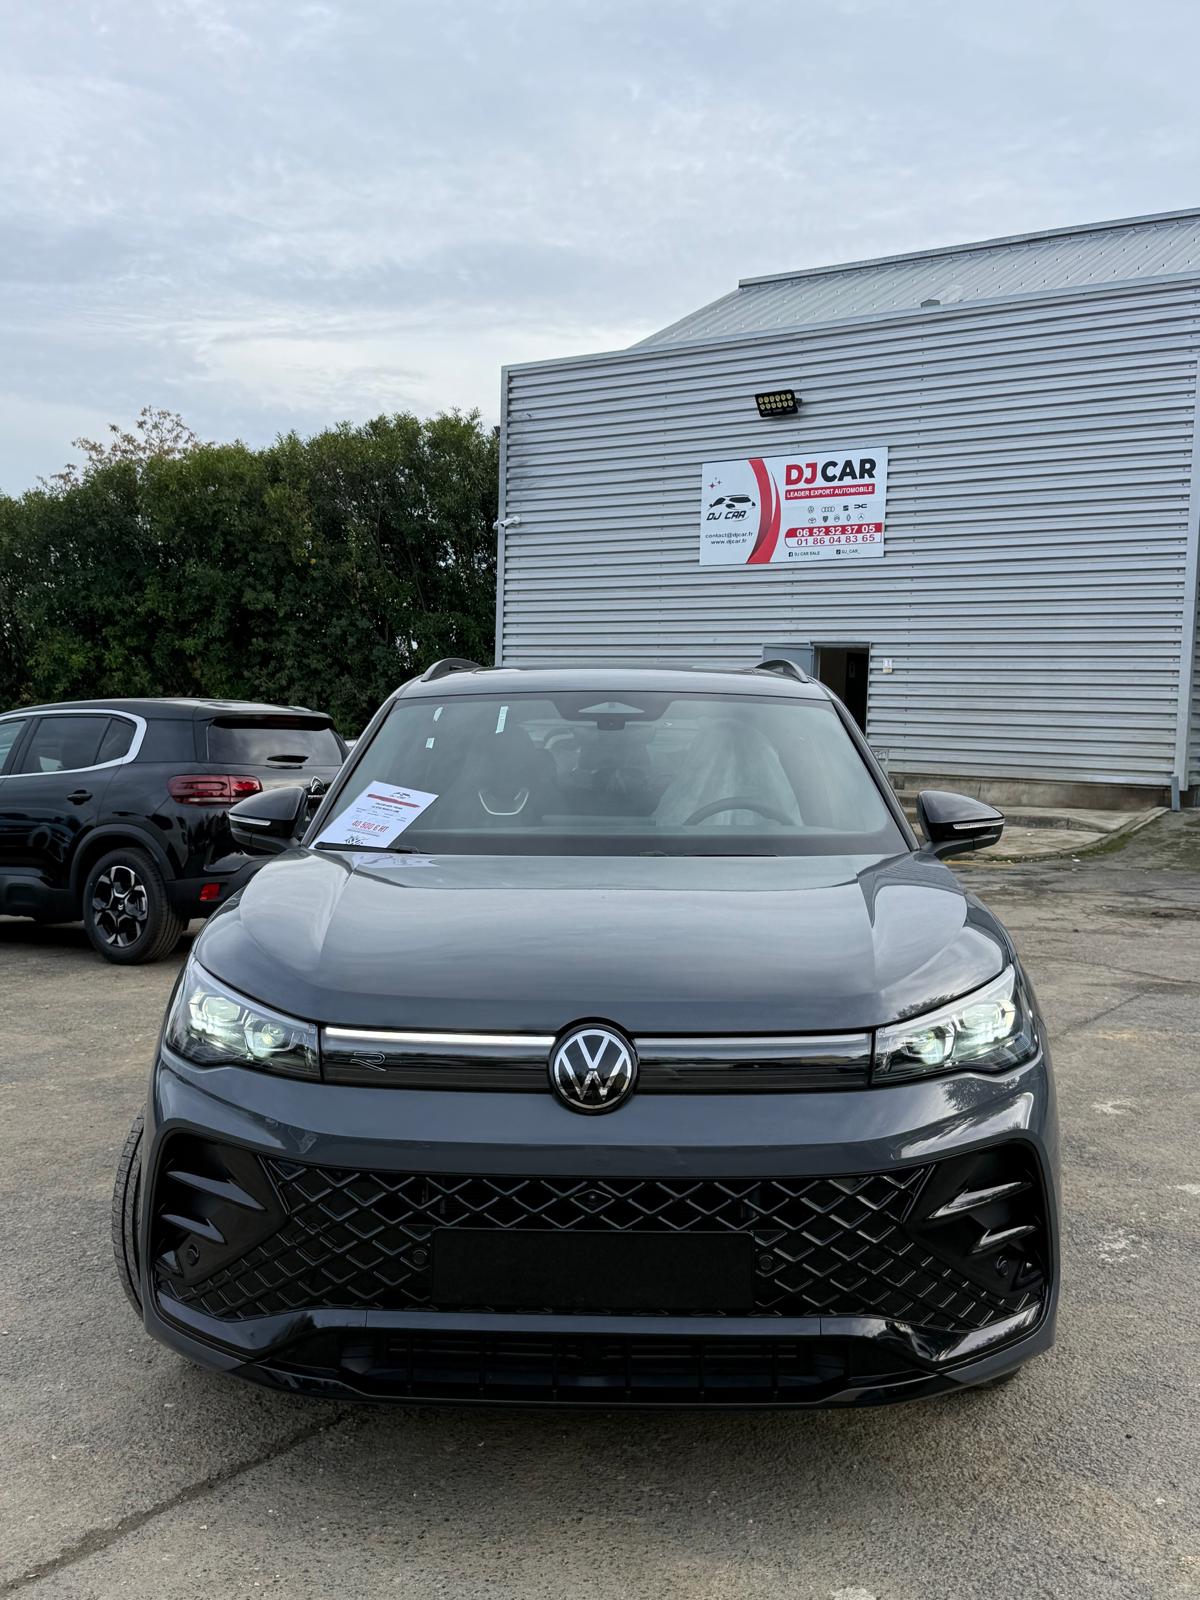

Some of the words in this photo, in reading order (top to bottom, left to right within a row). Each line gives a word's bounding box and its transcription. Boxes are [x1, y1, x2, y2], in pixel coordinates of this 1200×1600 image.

[785, 462, 818, 486] DJ
[821, 458, 876, 482] CAR
[786, 490, 810, 498] LEADER
[811, 488, 834, 496] EXPORT
[834, 485, 873, 495] AUTOMOBILE
[706, 512, 722, 520] DJ
[724, 510, 747, 519] CAR
[705, 531, 753, 539] contact@djcar.fr
[796, 529, 809, 537] 06
[812, 528, 826, 536] 52
[828, 527, 842, 535] 32
[845, 525, 858, 534] 37
[861, 524, 875, 533] 05
[796, 538, 809, 546] 01
[812, 537, 826, 545] 86
[828, 536, 842, 544] 04
[845, 535, 858, 543] 83
[861, 533, 875, 542] 65
